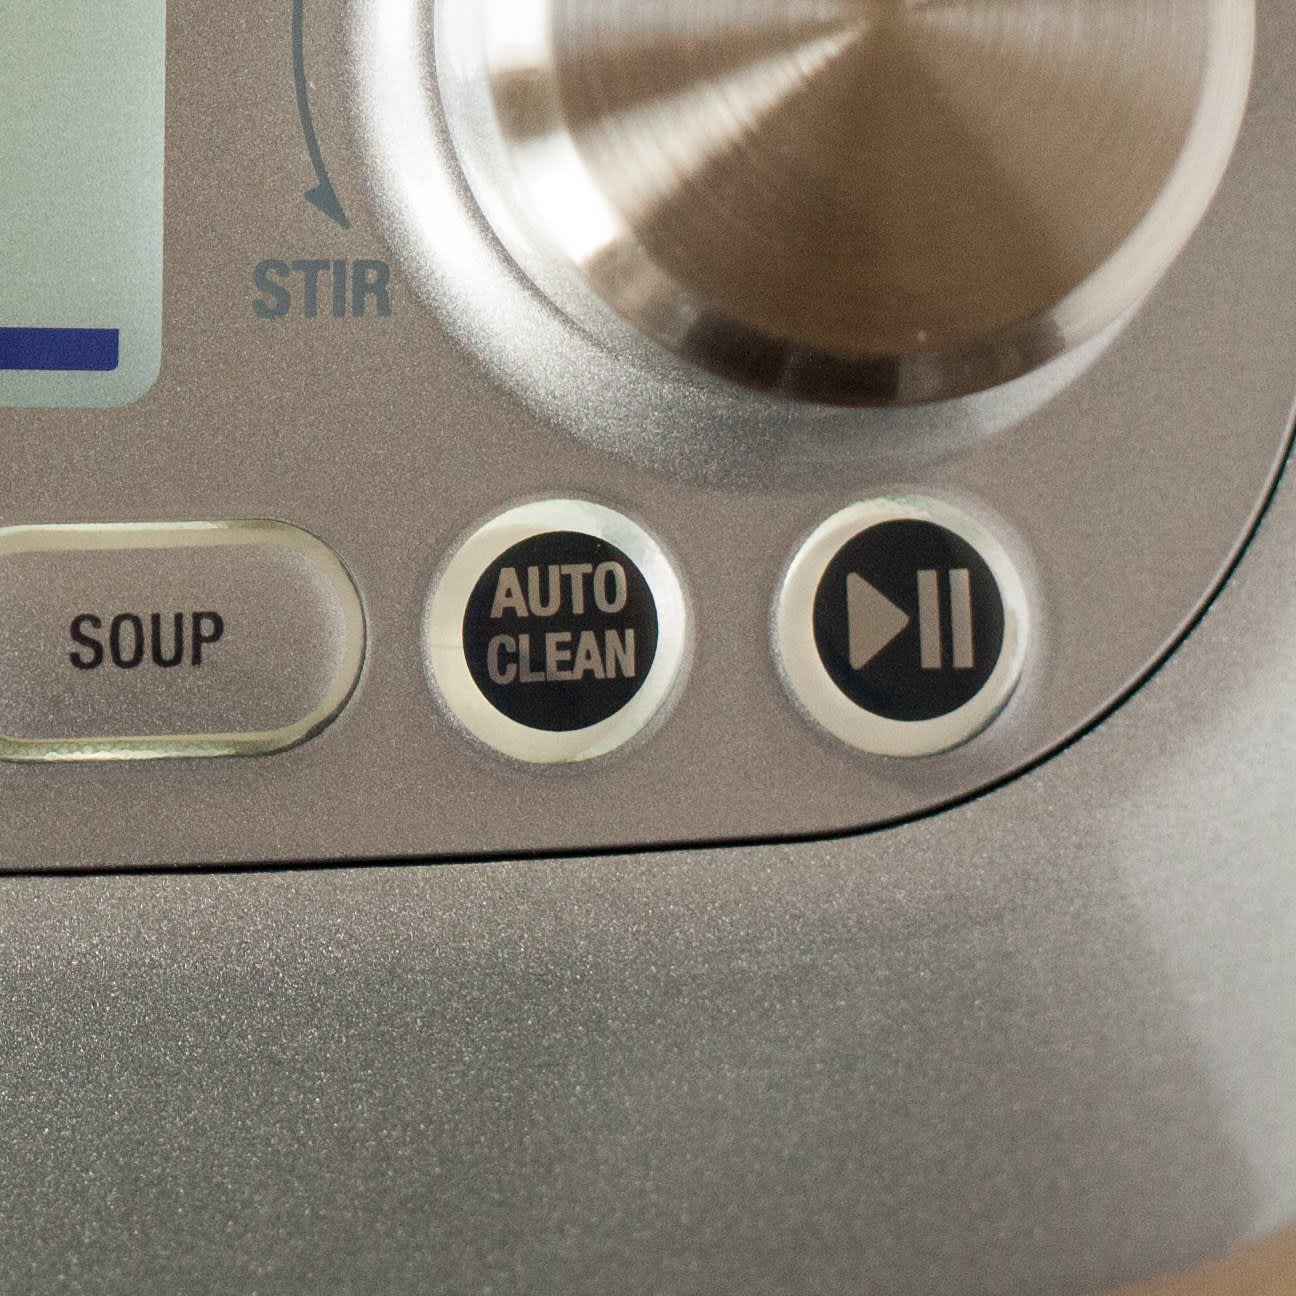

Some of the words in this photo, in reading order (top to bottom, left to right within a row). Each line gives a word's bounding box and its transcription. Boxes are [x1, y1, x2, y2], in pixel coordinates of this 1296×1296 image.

[252, 258, 391, 320] STIR
[489, 560, 628, 620] AUTO
[68, 609, 225, 671] SOUP
[486, 627, 637, 686] CLEAN
